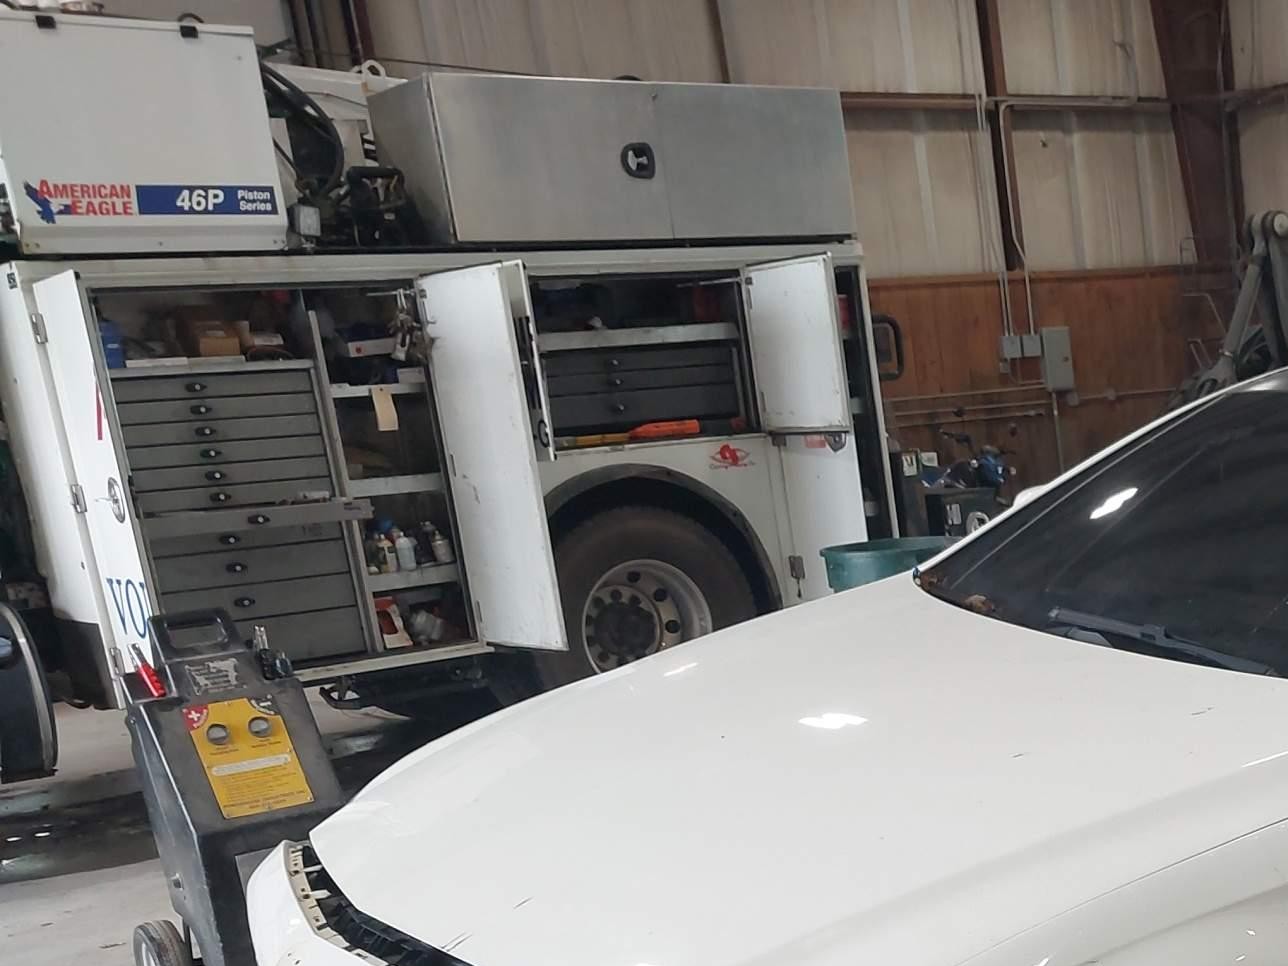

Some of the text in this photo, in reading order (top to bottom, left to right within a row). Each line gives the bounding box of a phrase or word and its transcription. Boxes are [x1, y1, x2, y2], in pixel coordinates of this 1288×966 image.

[37, 179, 131, 199] AMERICAN
[237, 189, 271, 201] Piston
[71, 200, 134, 216] EAGLE
[175, 189, 225, 211] 46P
[239, 201, 272, 212] Series
